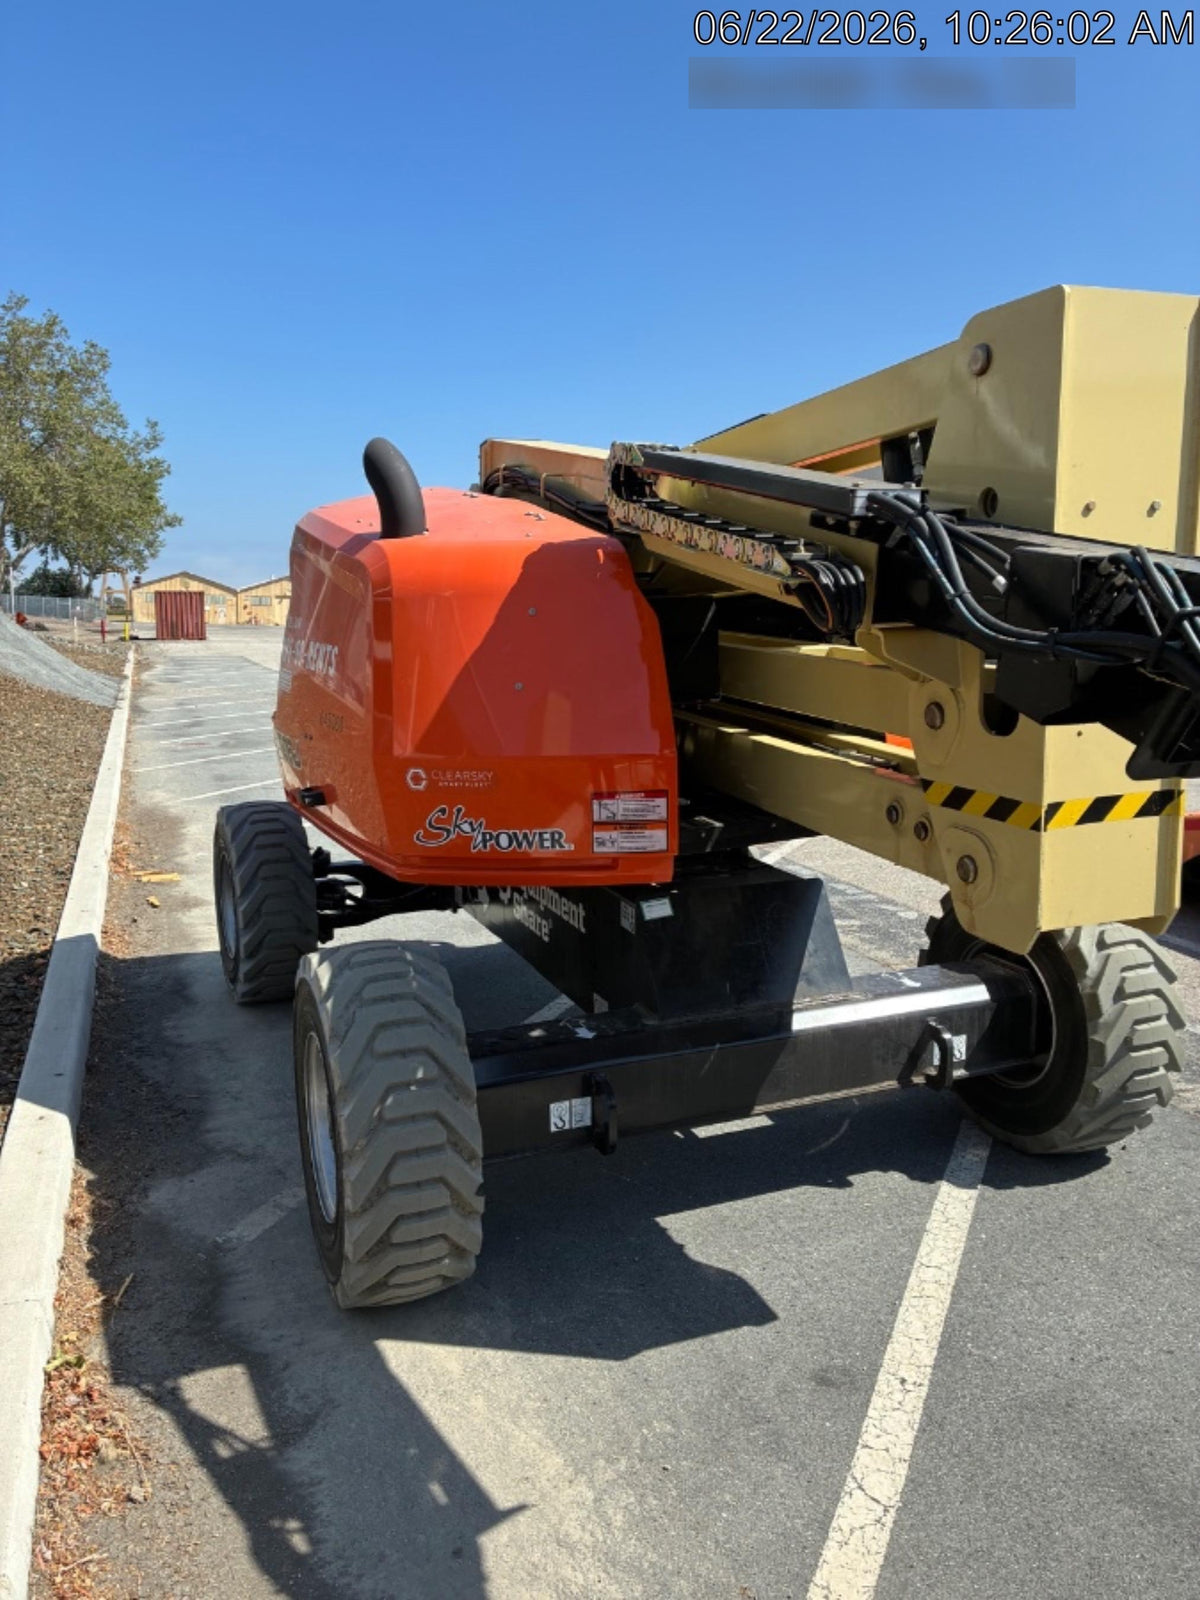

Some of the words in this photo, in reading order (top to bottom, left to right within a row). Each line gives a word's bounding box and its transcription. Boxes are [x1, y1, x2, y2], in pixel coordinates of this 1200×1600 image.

[431, 769, 493, 782] CLEARSKY
[414, 804, 485, 852] Sky
[480, 830, 566, 851] POWER
[512, 891, 550, 943] Share
